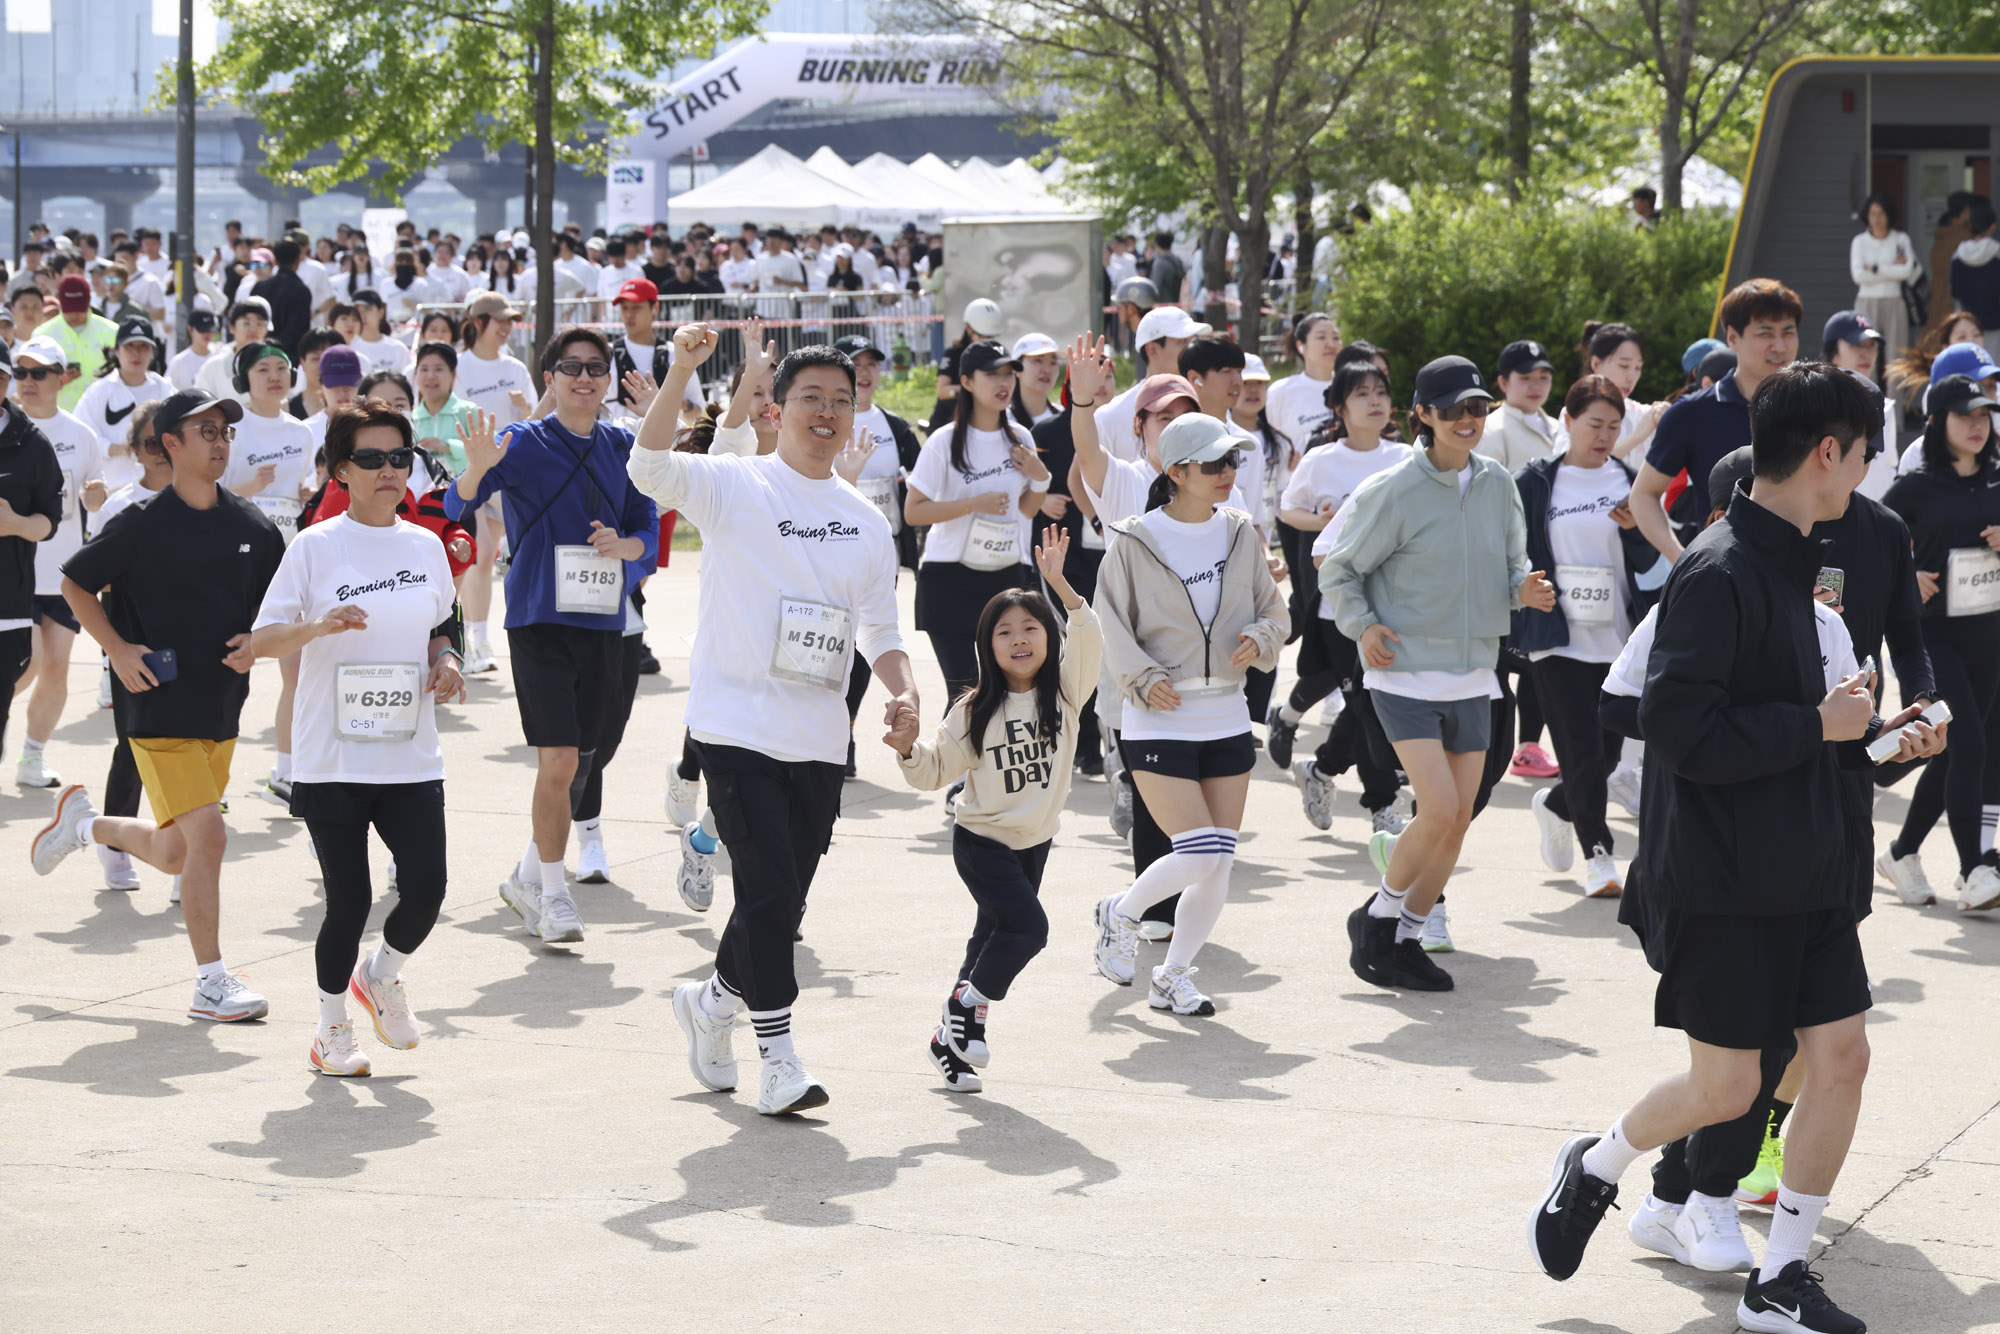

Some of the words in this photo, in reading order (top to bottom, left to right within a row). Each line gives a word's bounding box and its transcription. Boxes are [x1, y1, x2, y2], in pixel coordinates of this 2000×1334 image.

[797, 59, 928, 84] BURNING
[937, 60, 999, 84] RUN
[645, 66, 743, 140] START
[247, 453, 284, 466] Burning
[283, 445, 302, 455] Run
[963, 466, 1002, 485] Burning
[1548, 502, 1597, 520] Burning
[1597, 496, 1618, 508] Ru
[827, 521, 860, 537] Run
[336, 577, 397, 602] Burning
[396, 570, 428, 586] Run
[566, 571, 577, 581] M
[578, 570, 617, 585] 5183
[1959, 576, 1969, 585] W
[1571, 587, 1610, 601] 6335
[787, 606, 814, 616] A-172
[787, 630, 801, 642] M
[802, 631, 845, 655] 5104
[345, 693, 359, 704] W
[361, 690, 414, 707] 6329
[350, 719, 375, 730] C-51
[1004, 759, 1054, 794] Day
